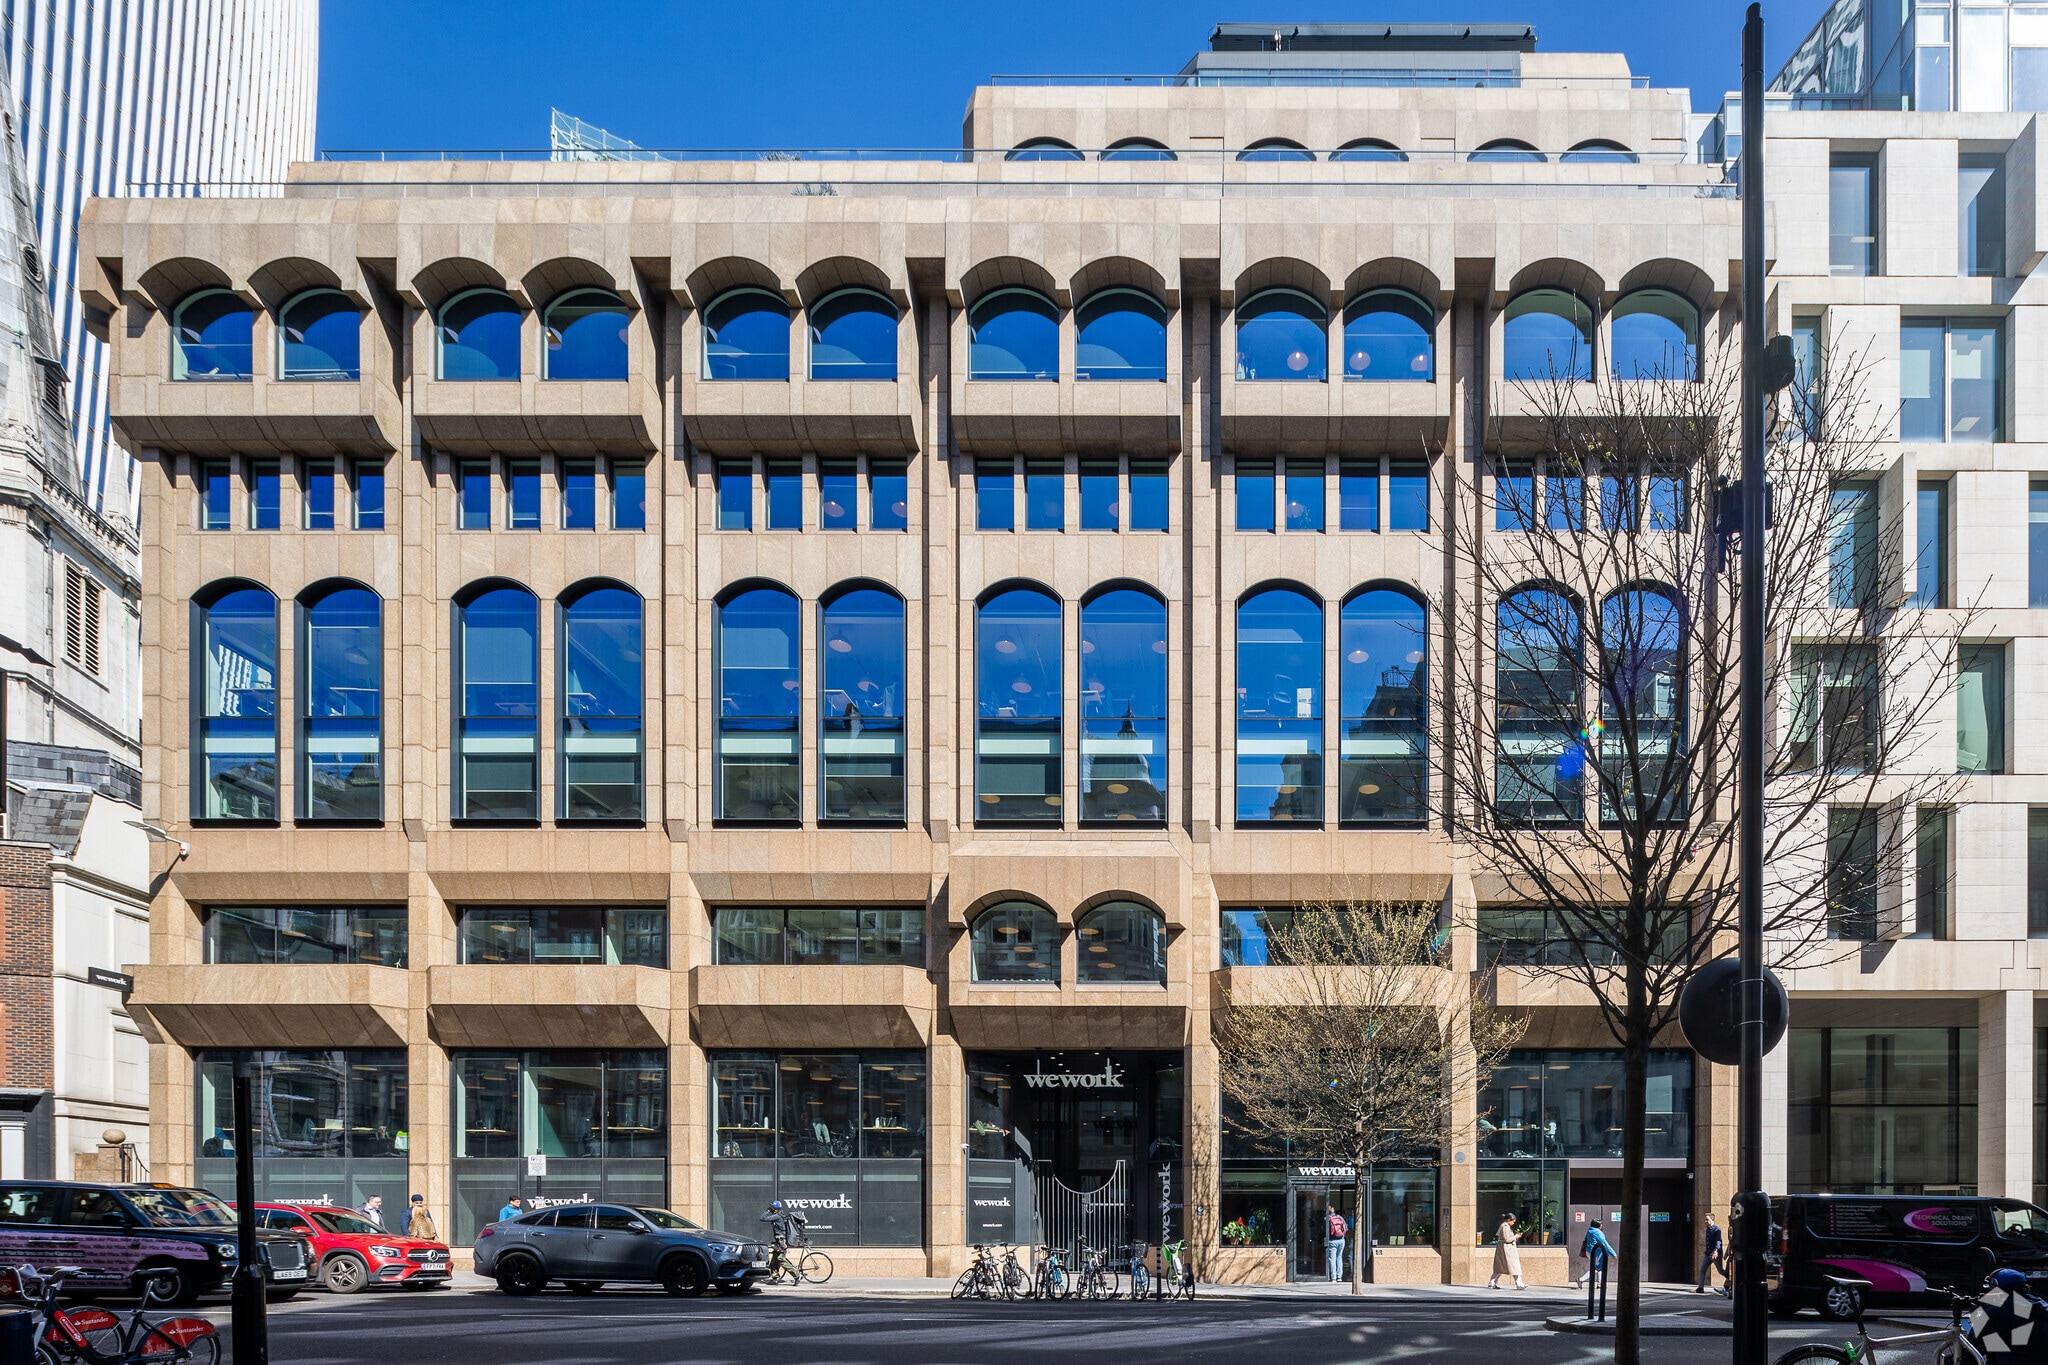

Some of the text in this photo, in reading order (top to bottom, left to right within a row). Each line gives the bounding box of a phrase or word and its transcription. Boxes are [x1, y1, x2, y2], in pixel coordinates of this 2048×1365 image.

[95, 974, 127, 986] wework
[1023, 1065, 1124, 1088] wework
[784, 1193, 853, 1209] wework
[973, 1196, 1011, 1207] wework
[1157, 1162, 1171, 1245] wework
[81, 1317, 109, 1325] Santander
[175, 1325, 205, 1334] Santander
